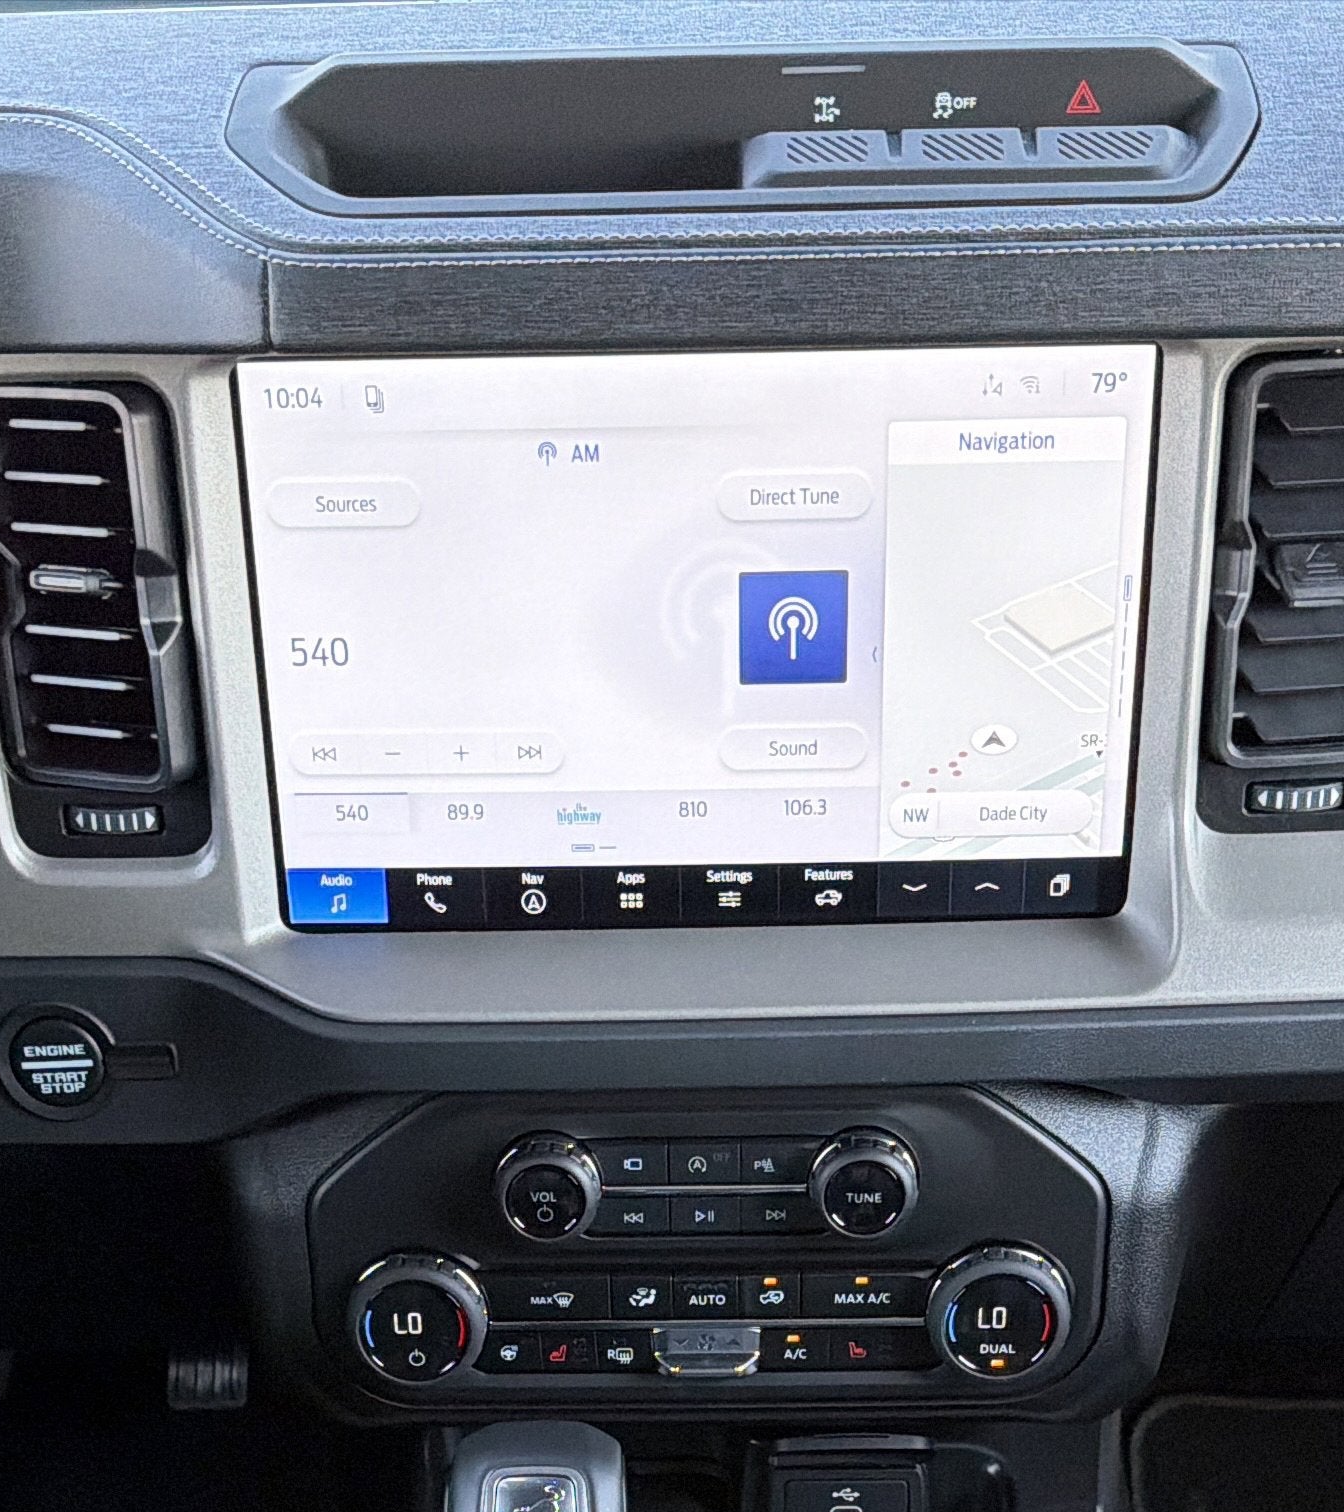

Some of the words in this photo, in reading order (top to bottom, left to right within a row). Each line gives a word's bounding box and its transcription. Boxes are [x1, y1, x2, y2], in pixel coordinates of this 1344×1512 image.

[953, 96, 977, 110] OFF
[1090, 371, 1128, 394] 79°
[262, 386, 323, 410] 10:04
[958, 430, 1056, 454] Navigation
[570, 443, 600, 463] AM
[314, 495, 378, 514] Sources
[749, 487, 796, 507] Direct
[799, 486, 840, 506] Tune
[290, 637, 350, 667] 540
[768, 739, 818, 758] Sound
[1080, 734, 1108, 748] SR-
[335, 803, 370, 822] 540
[446, 802, 485, 821] 89.9
[678, 801, 708, 819] 810
[784, 798, 827, 817] 106.3
[902, 806, 930, 824] NW
[979, 805, 1017, 822] Dade
[1019, 805, 1048, 823] City
[557, 808, 602, 825] highway
[320, 873, 353, 887] Audio
[416, 872, 453, 887] Phone
[521, 872, 545, 886] Nav
[616, 871, 646, 888] Apps
[705, 868, 753, 885] Settings
[803, 867, 854, 883] Features
[23, 1043, 87, 1058] ENGINE
[31, 1070, 89, 1084] START
[40, 1081, 86, 1095] STOP
[529, 1191, 557, 1203] VOL
[845, 1192, 883, 1204] TUNE
[530, 1295, 554, 1305] MAX
[688, 1294, 726, 1307] AUTO
[833, 1293, 865, 1305] MAX
[866, 1292, 892, 1305] A/C
[393, 1312, 423, 1335] LO
[977, 1306, 1007, 1330] LO
[783, 1347, 807, 1360] A/C
[979, 1342, 1016, 1355] DUAL
